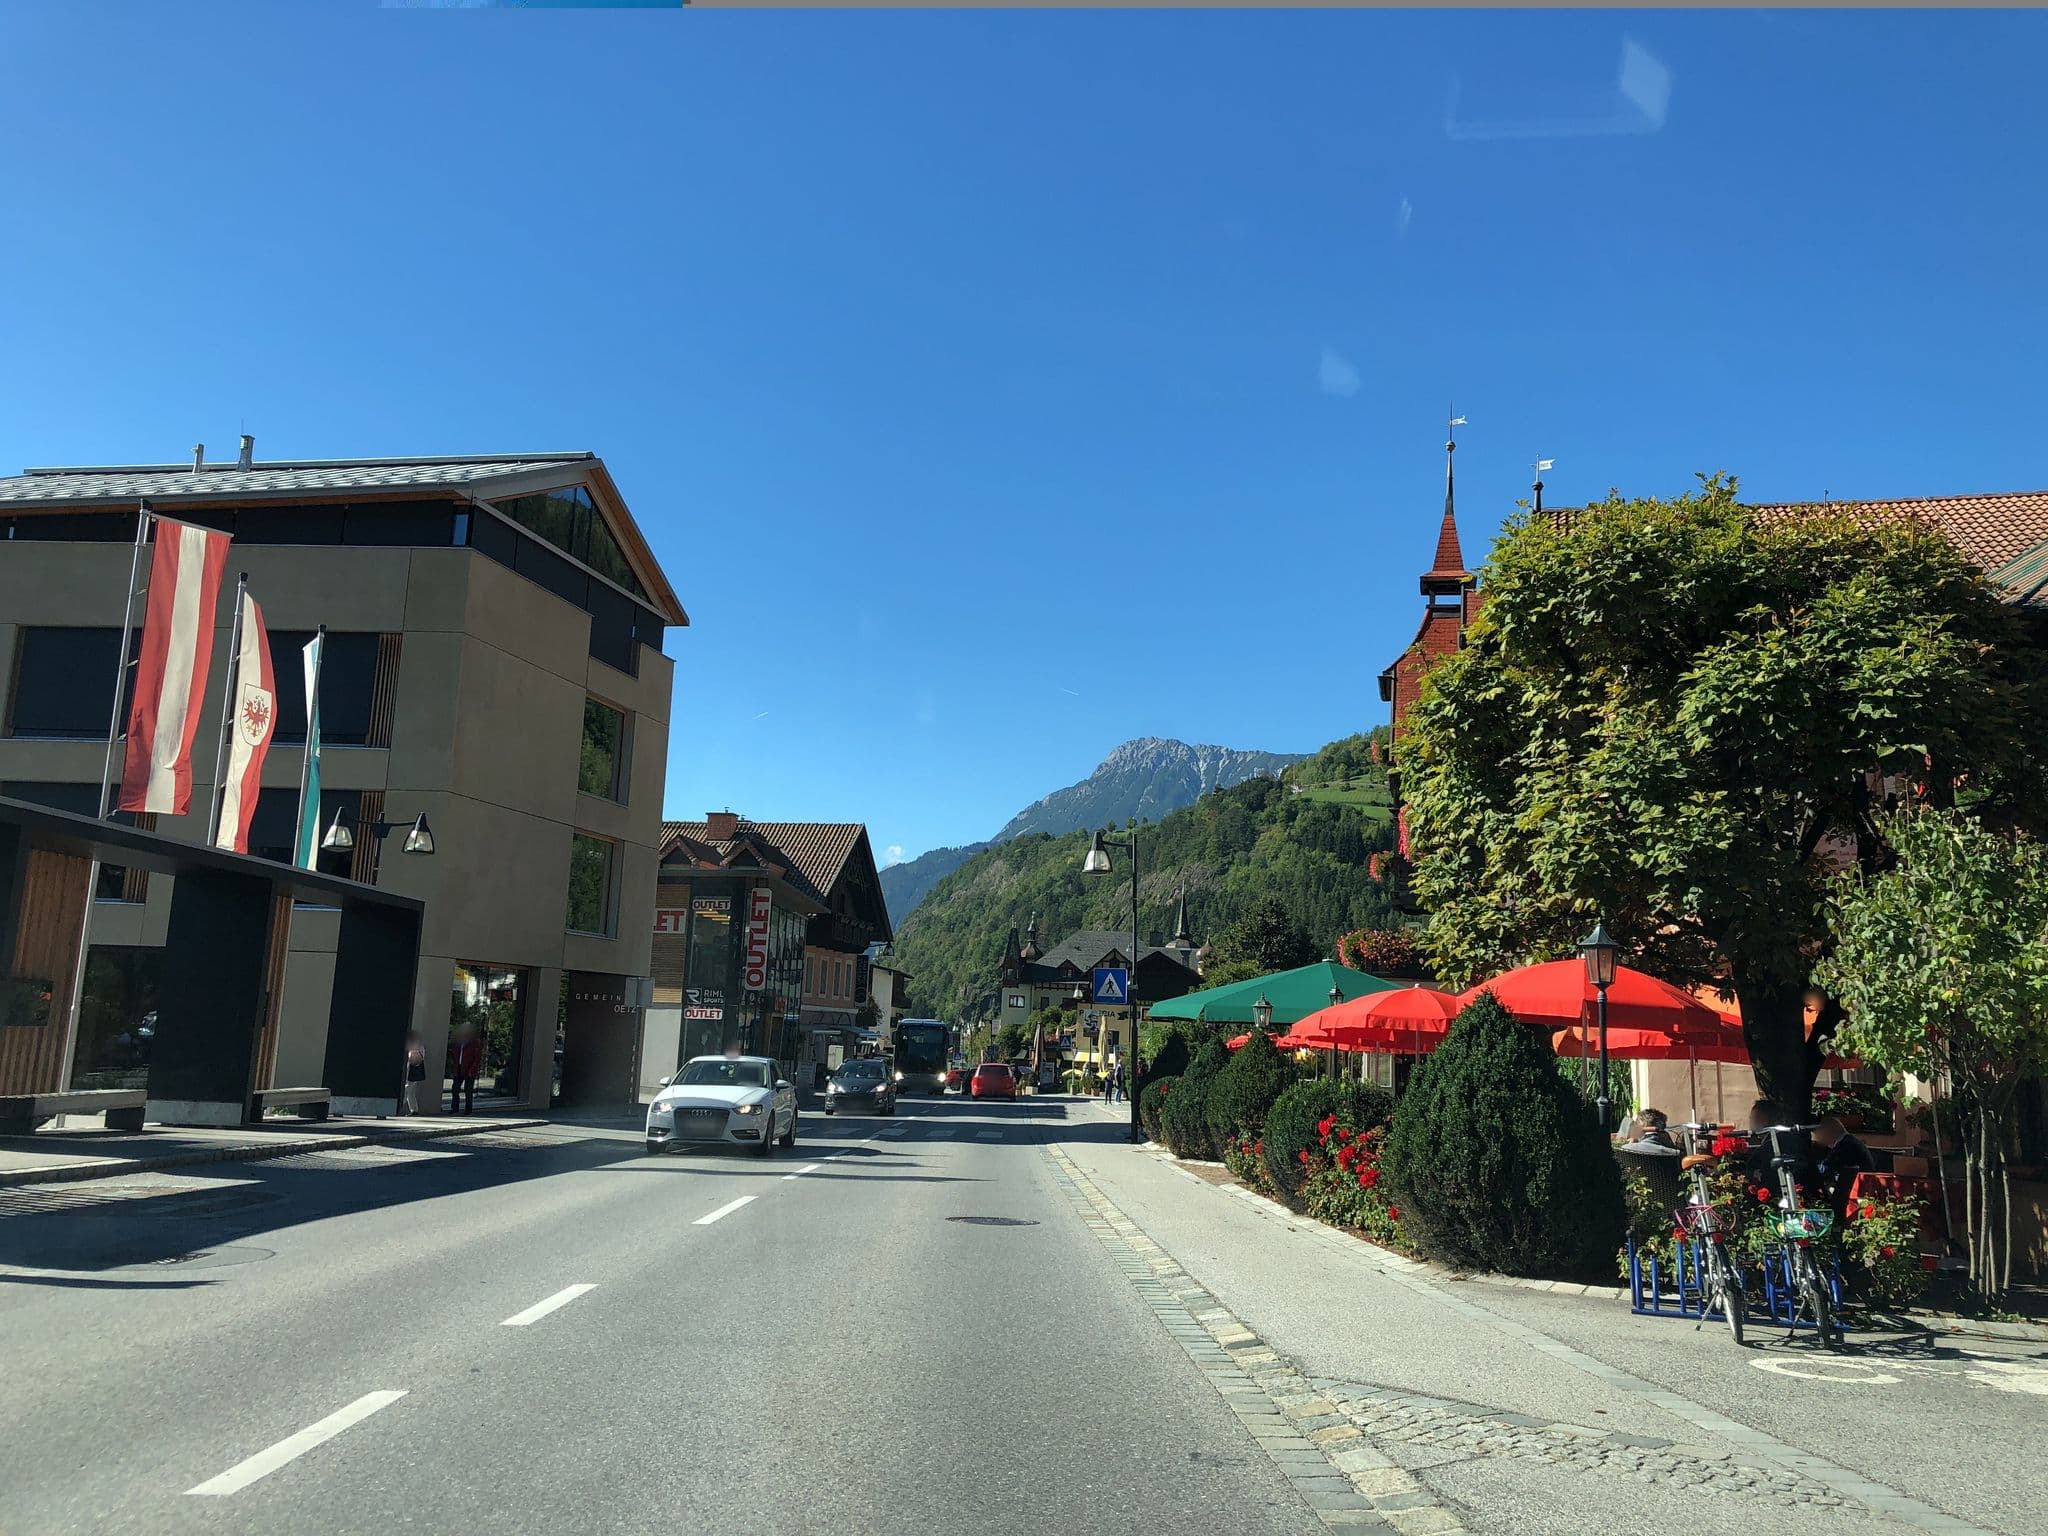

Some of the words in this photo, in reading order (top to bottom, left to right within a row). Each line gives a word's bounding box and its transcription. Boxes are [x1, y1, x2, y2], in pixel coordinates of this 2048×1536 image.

[693, 900, 730, 909] OUTLET
[653, 910, 685, 932] ET
[746, 890, 770, 988] OUTLET
[703, 989, 724, 998] RIML
[684, 1009, 722, 1018] OUTLET
